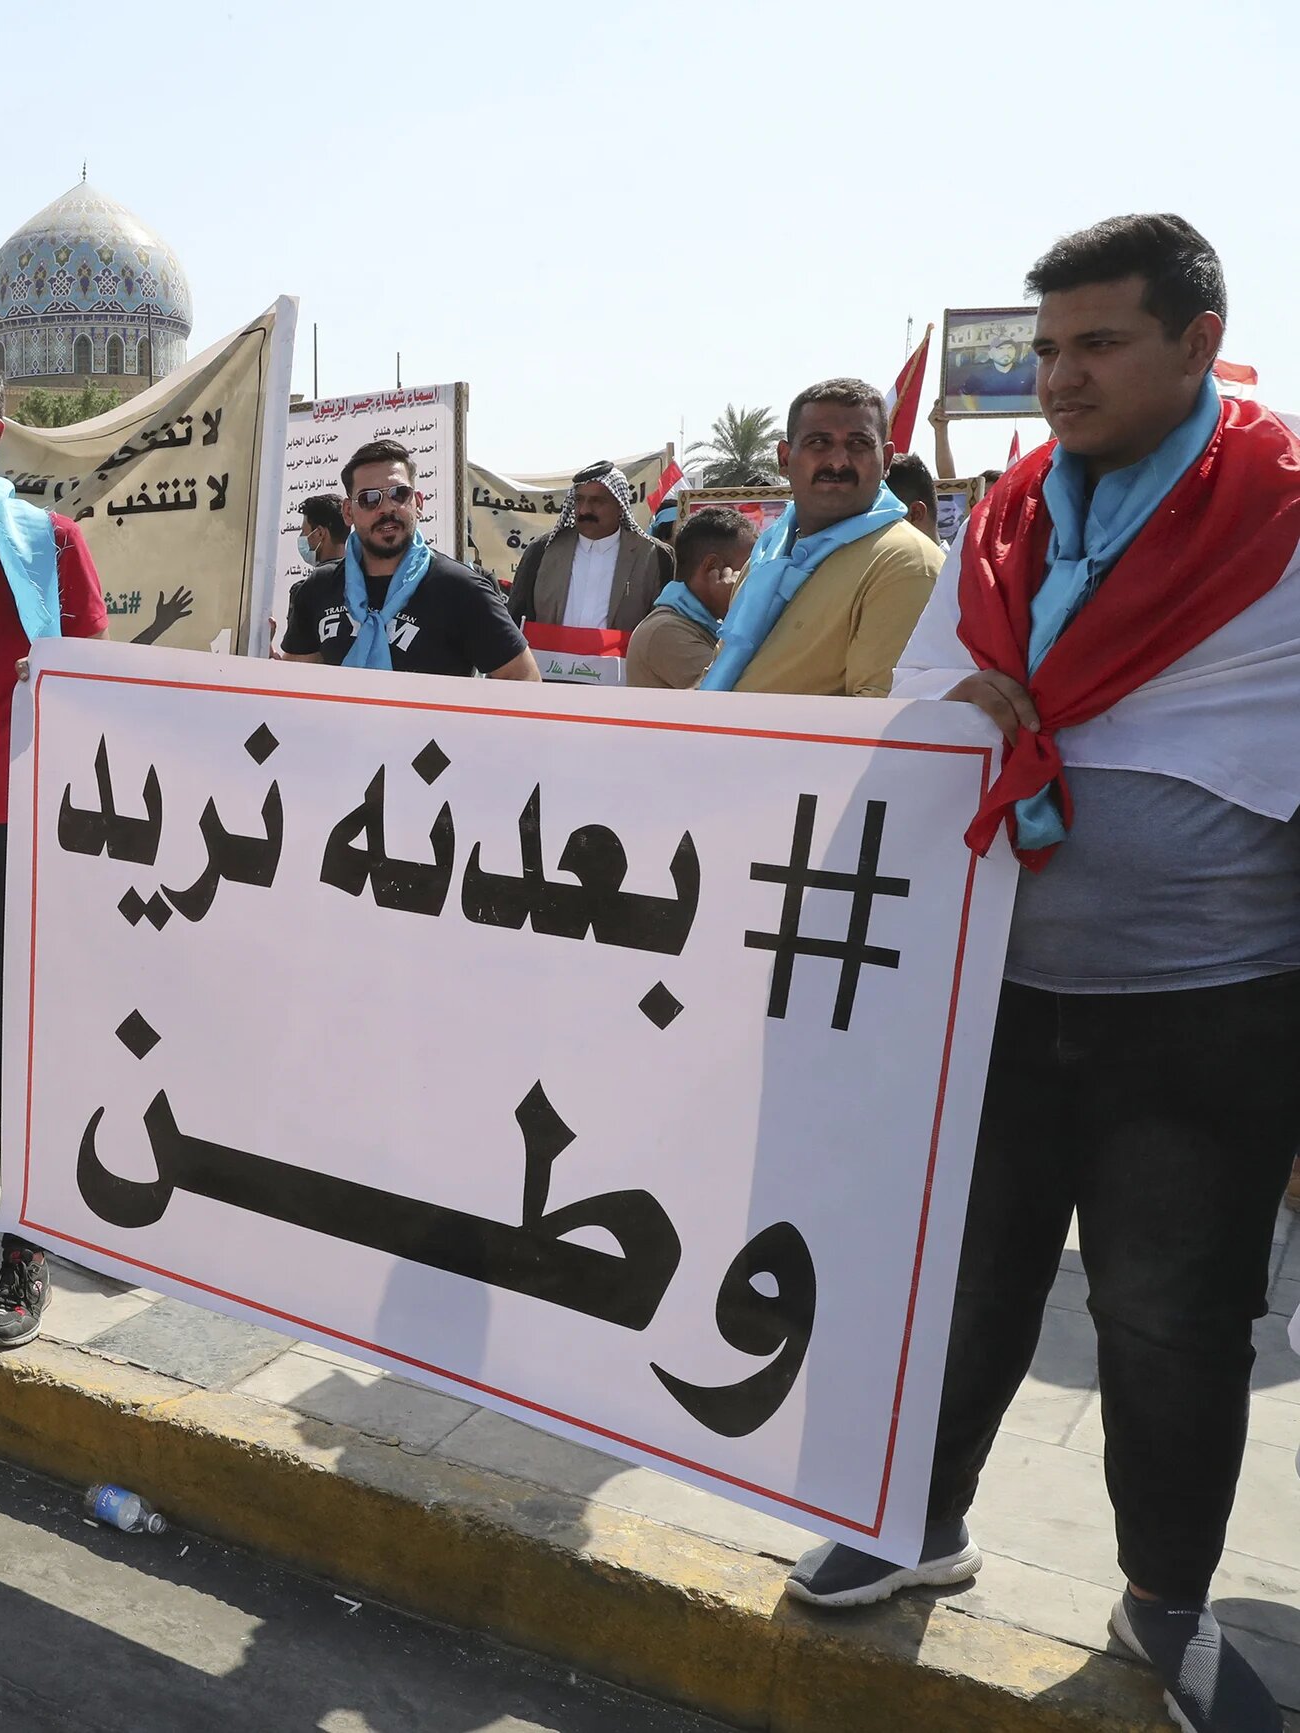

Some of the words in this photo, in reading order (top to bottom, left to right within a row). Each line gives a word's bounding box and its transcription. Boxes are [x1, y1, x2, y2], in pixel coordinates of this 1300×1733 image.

[202, 407, 222, 446] لا
[107, 476, 197, 527] تنتخب
[206, 472, 230, 511] لا
[57, 723, 285, 932] نريد
